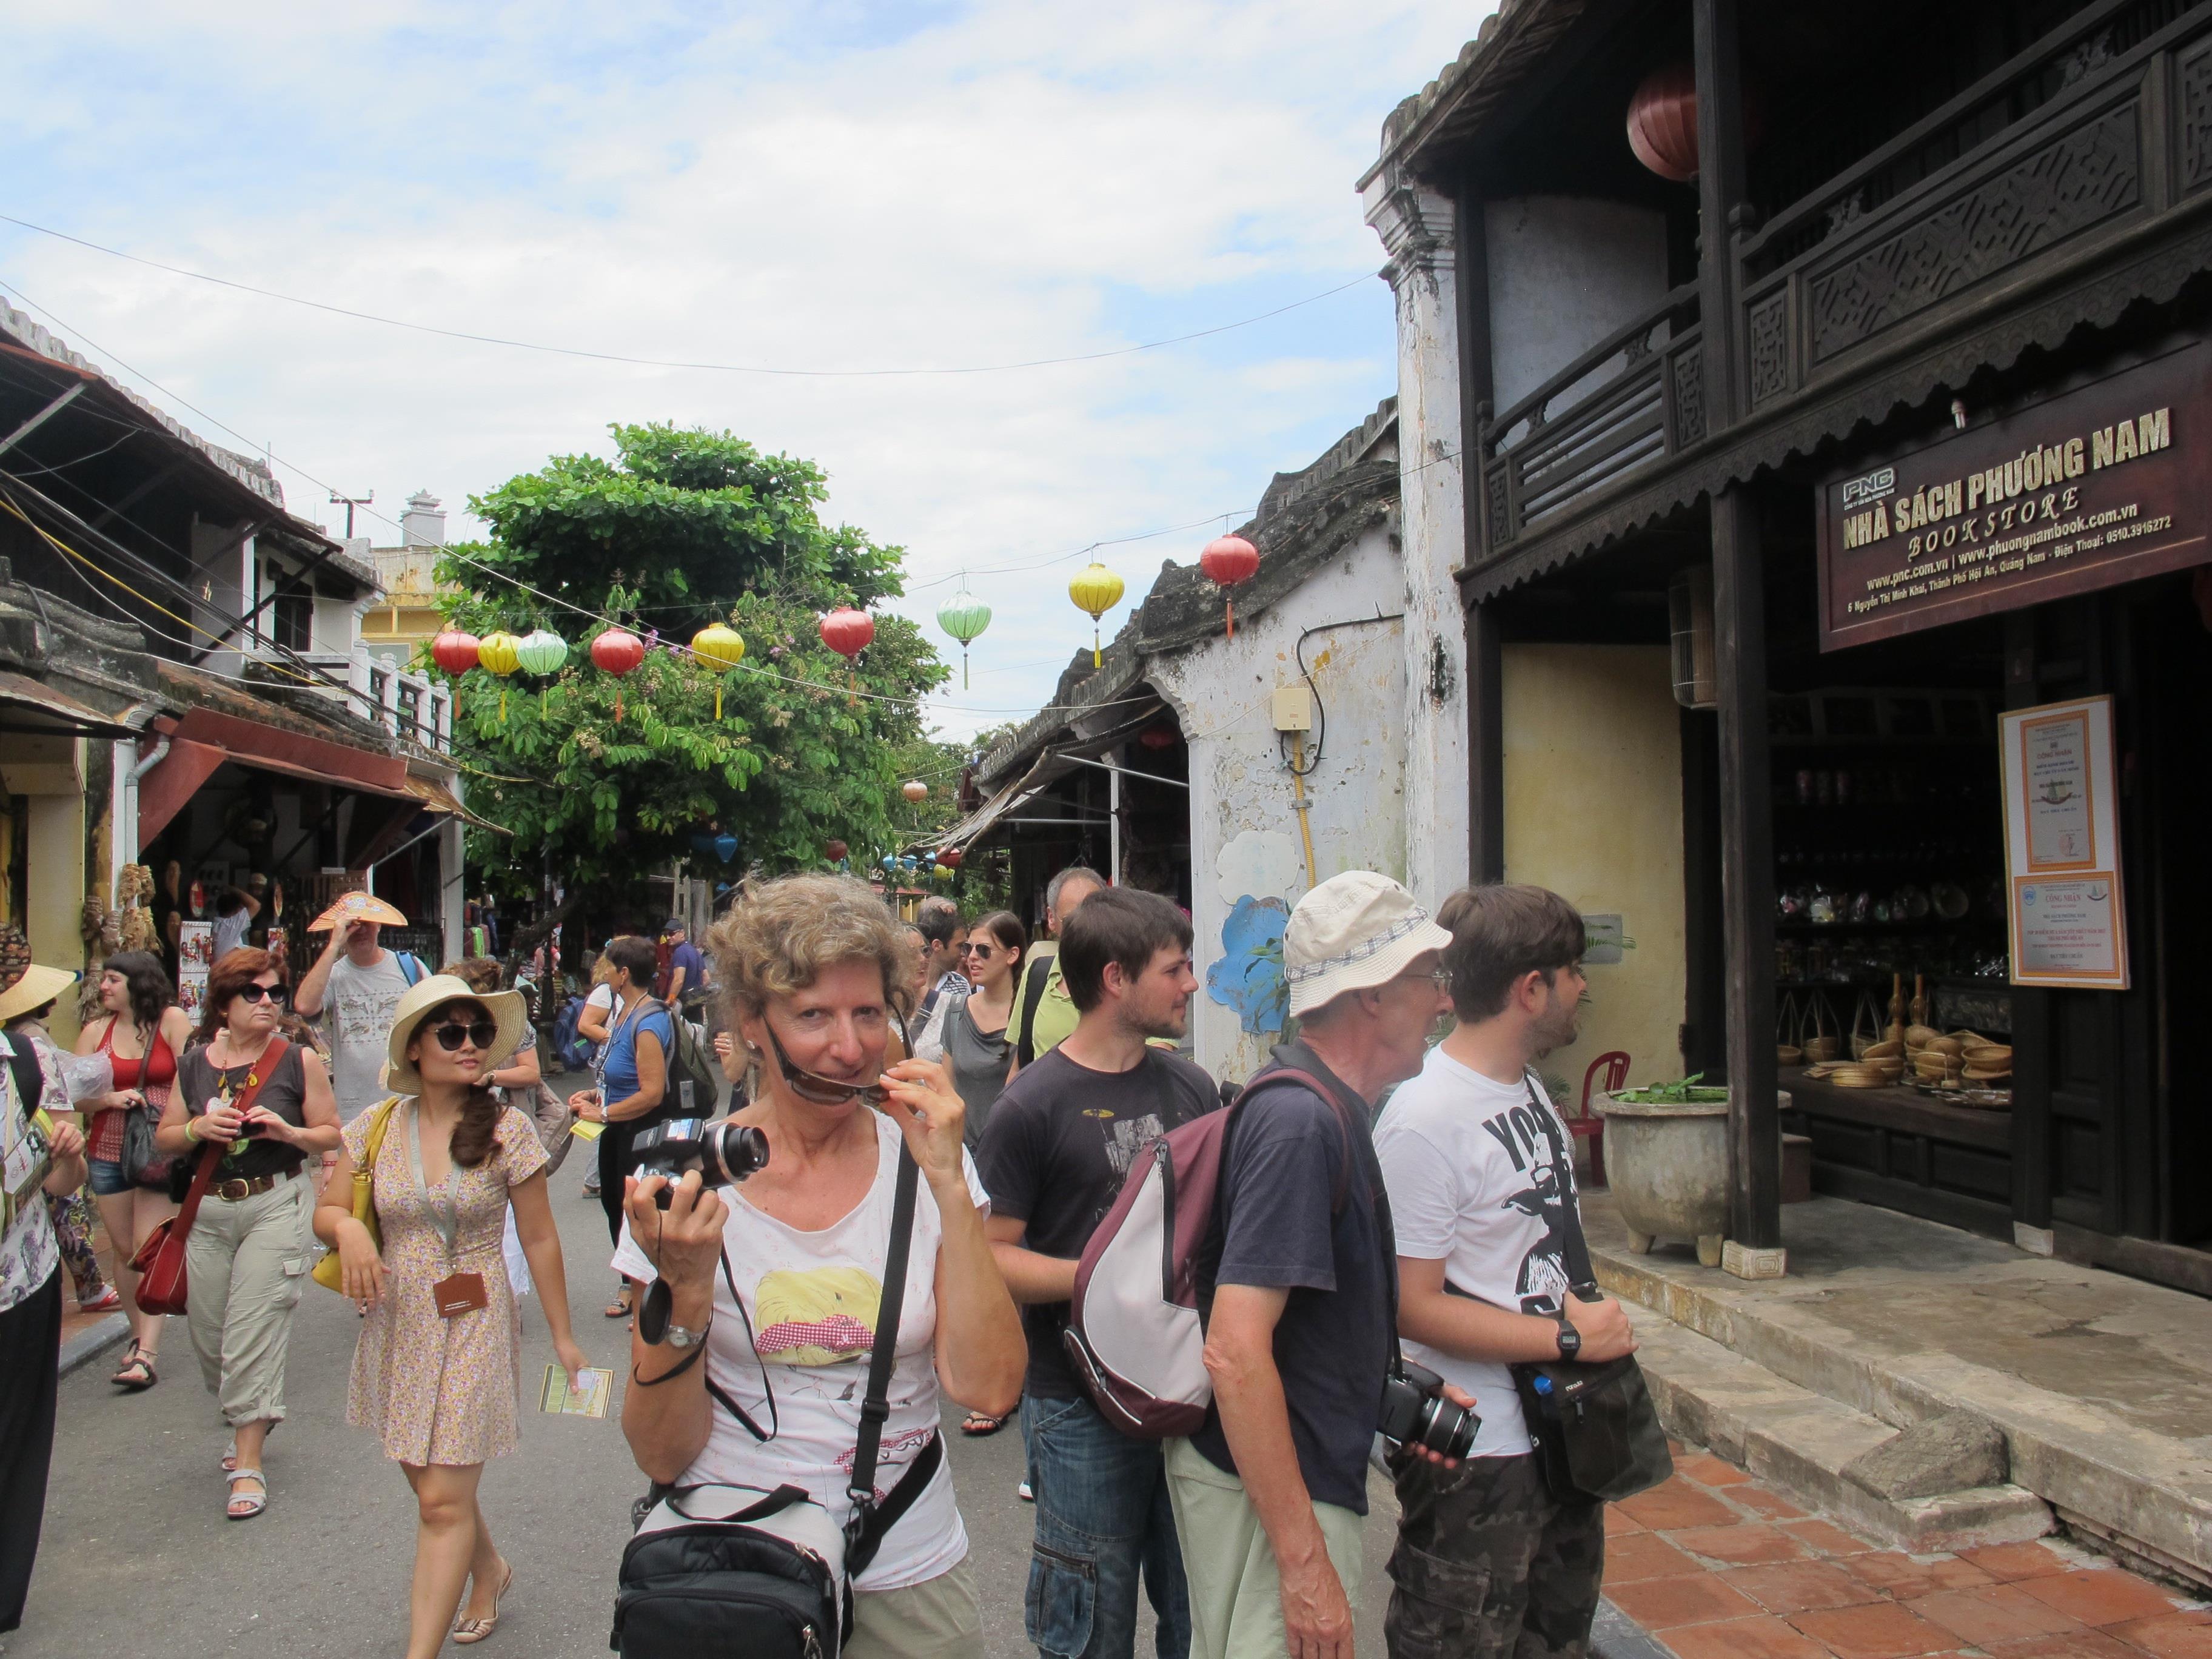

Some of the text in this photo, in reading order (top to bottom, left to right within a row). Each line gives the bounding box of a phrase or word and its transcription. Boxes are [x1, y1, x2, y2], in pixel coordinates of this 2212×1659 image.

[1843, 407, 2170, 550] NHÀ SÁCH PHƯƠNG NAM
[1848, 603, 1852, 612] 6
[1892, 588, 1908, 602] Minh
[1909, 583, 1927, 597] Khai,
[1984, 565, 1998, 577] An,
[2026, 552, 2046, 566] Nam
[2106, 515, 2172, 544] 0510.3916272
[1867, 504, 2138, 591] www.pnc.com.vn www.phuongnambook.com.vn
